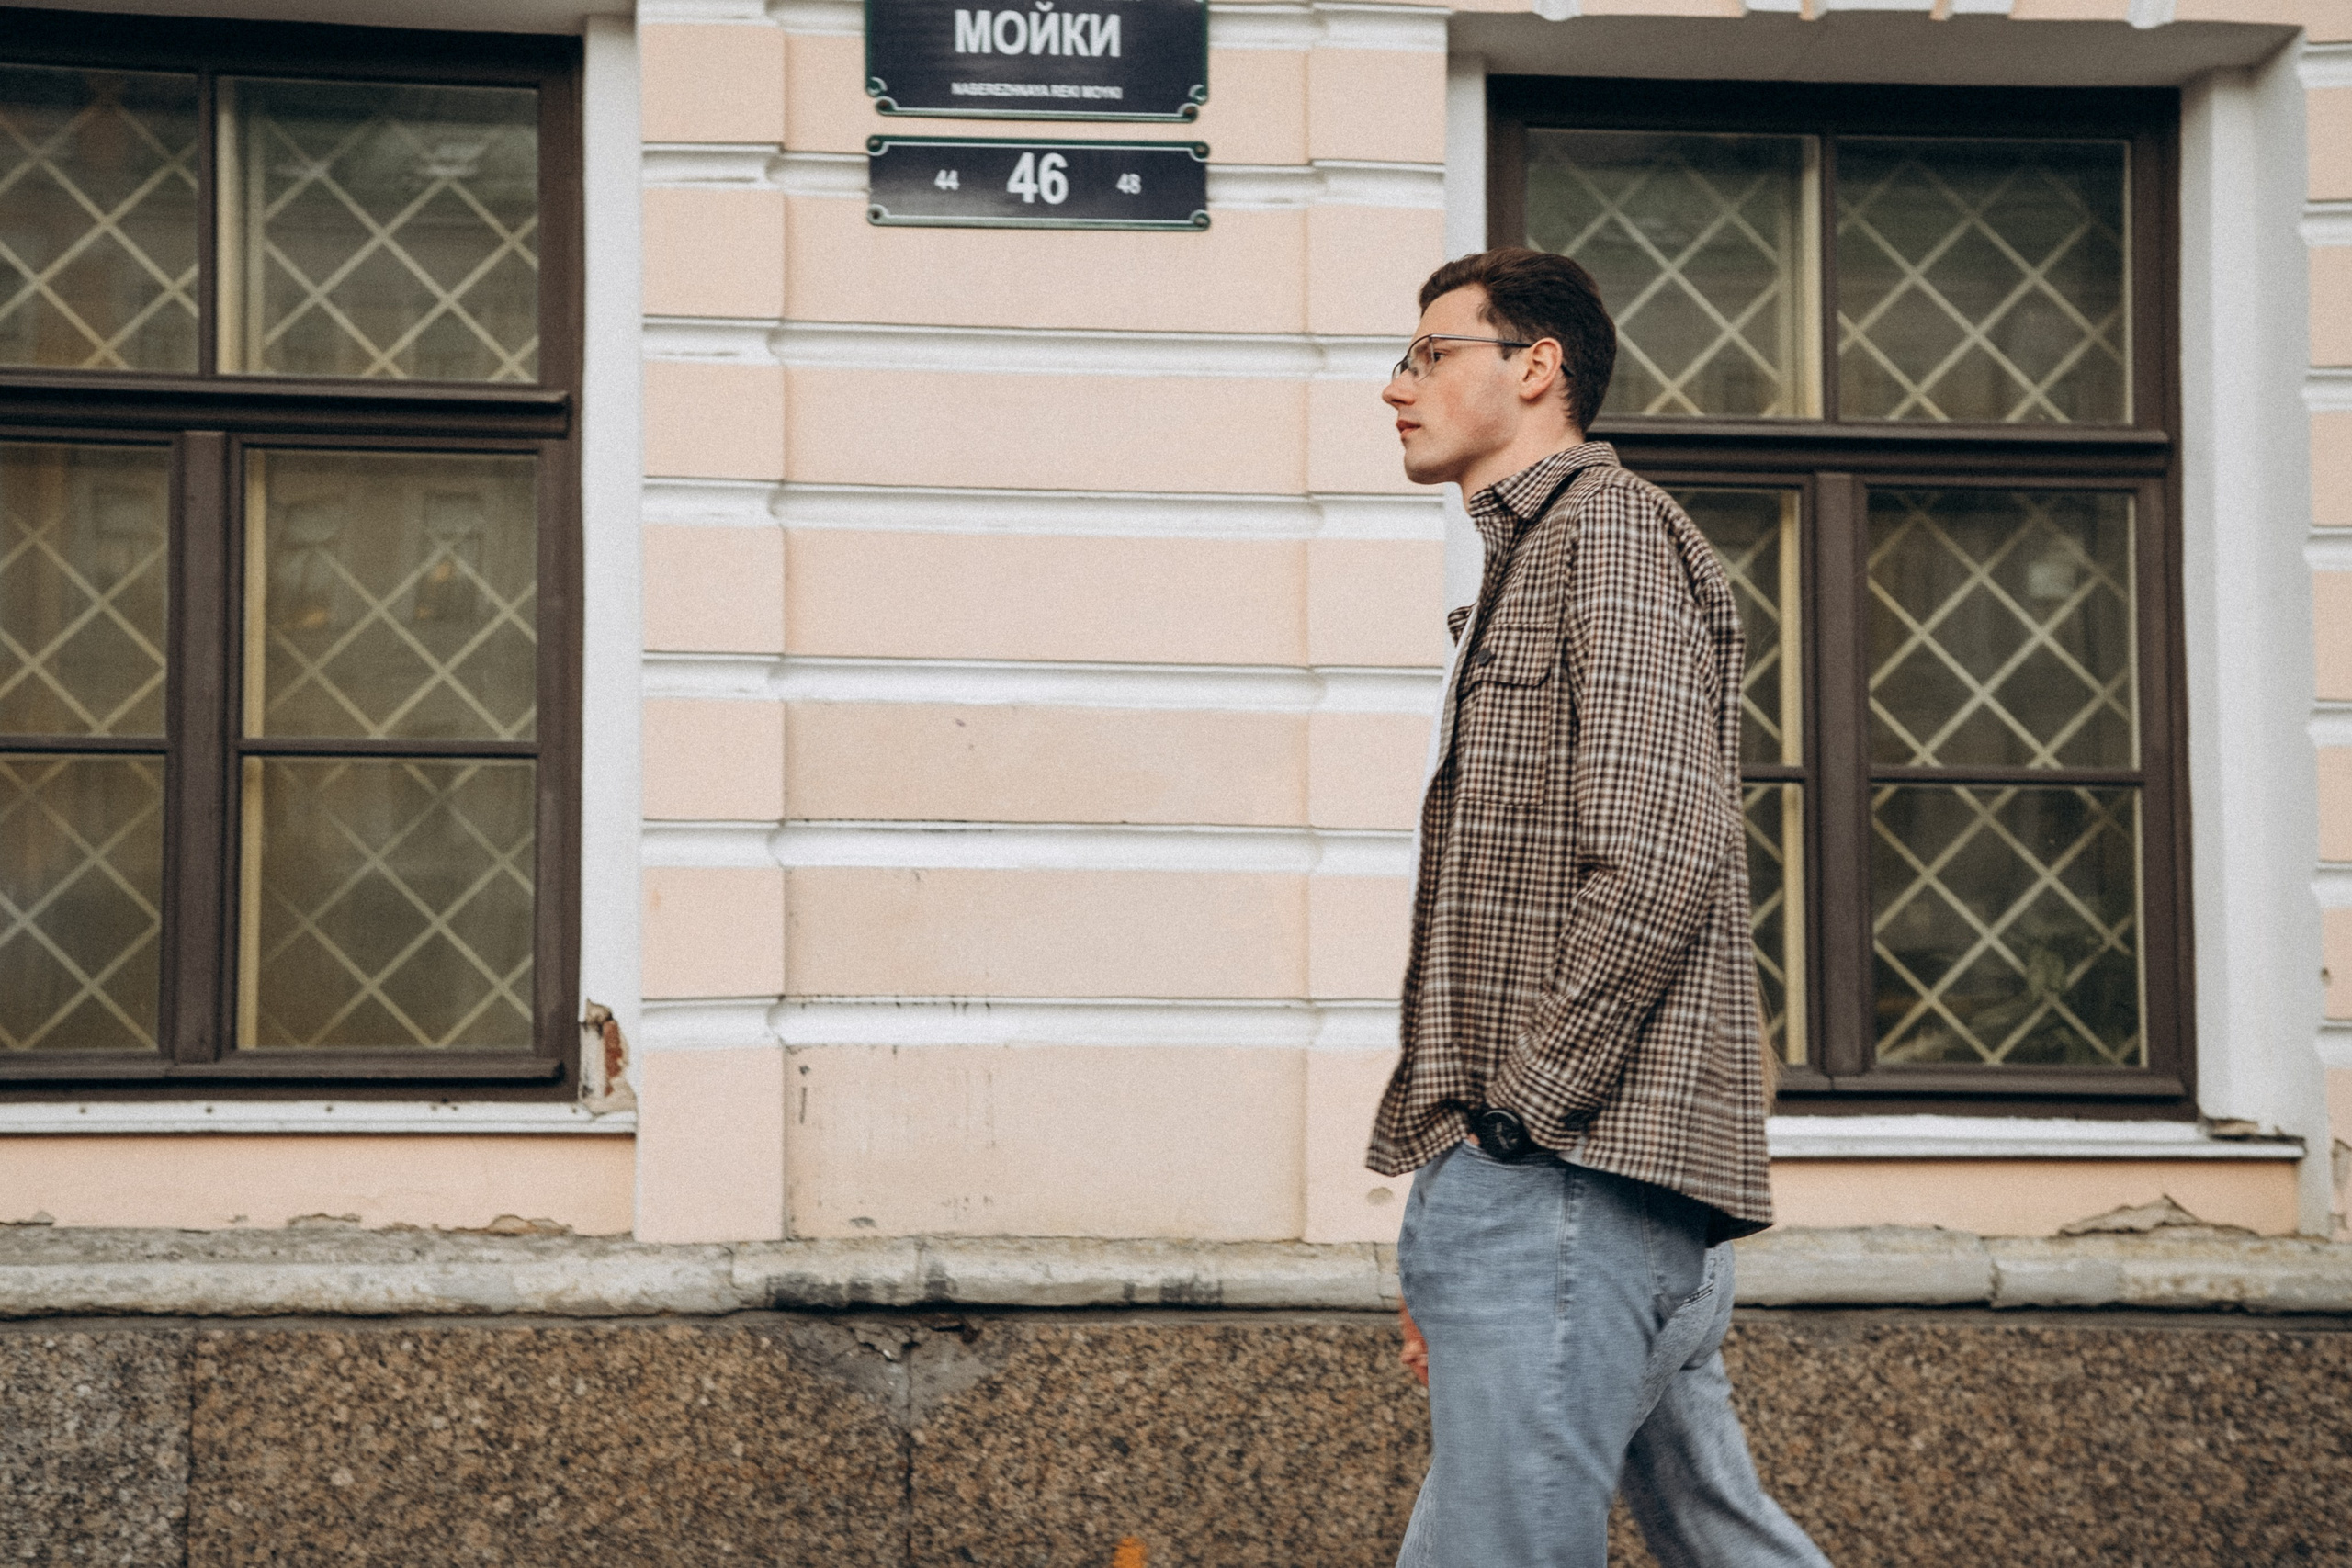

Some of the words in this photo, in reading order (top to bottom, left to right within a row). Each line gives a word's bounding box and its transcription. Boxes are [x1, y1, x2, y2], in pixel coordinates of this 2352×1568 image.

[954, 2, 1122, 57] МОЙКИ
[933, 169, 960, 191] 44
[1006, 152, 1069, 205] 46
